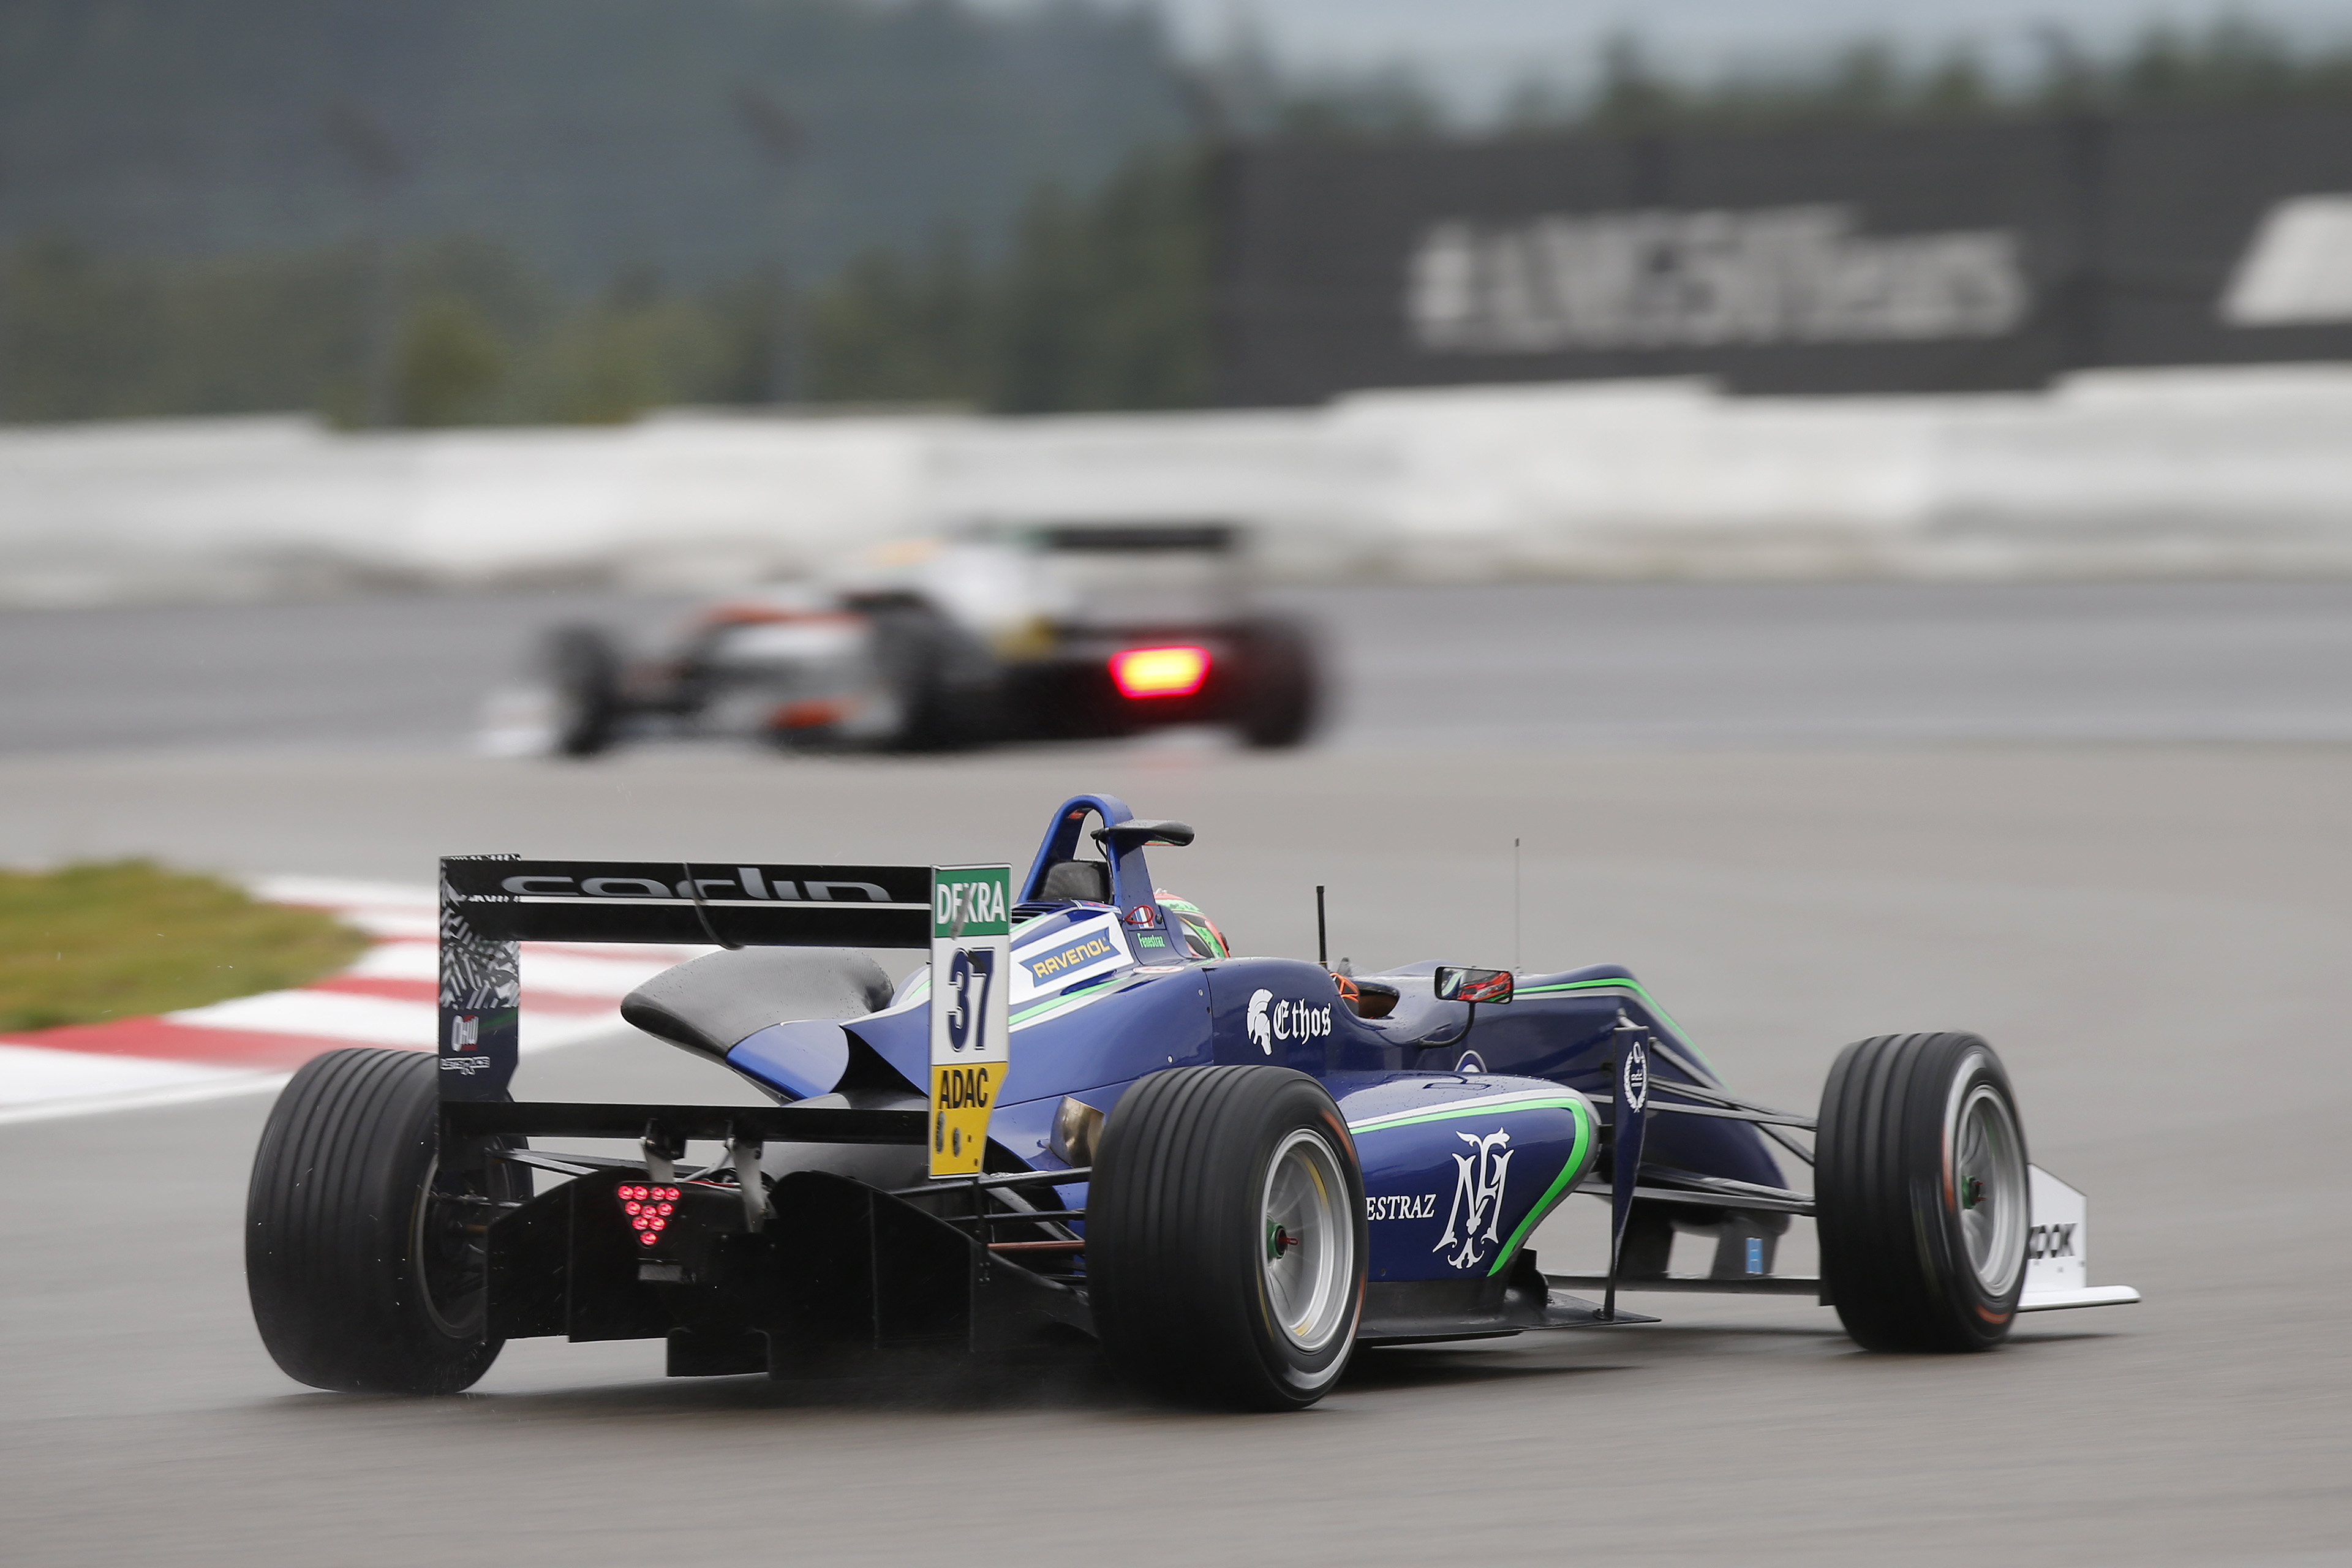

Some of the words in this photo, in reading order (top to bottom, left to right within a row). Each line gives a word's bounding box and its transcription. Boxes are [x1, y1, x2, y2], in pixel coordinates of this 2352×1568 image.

[501, 867, 892, 902] carlin
[936, 880, 1007, 925] DEKRA
[1032, 938, 1111, 979] RAVENOL
[947, 946, 995, 1052] 37
[1273, 998, 1332, 1045] Ethos
[938, 1068, 990, 1110] ADAC
